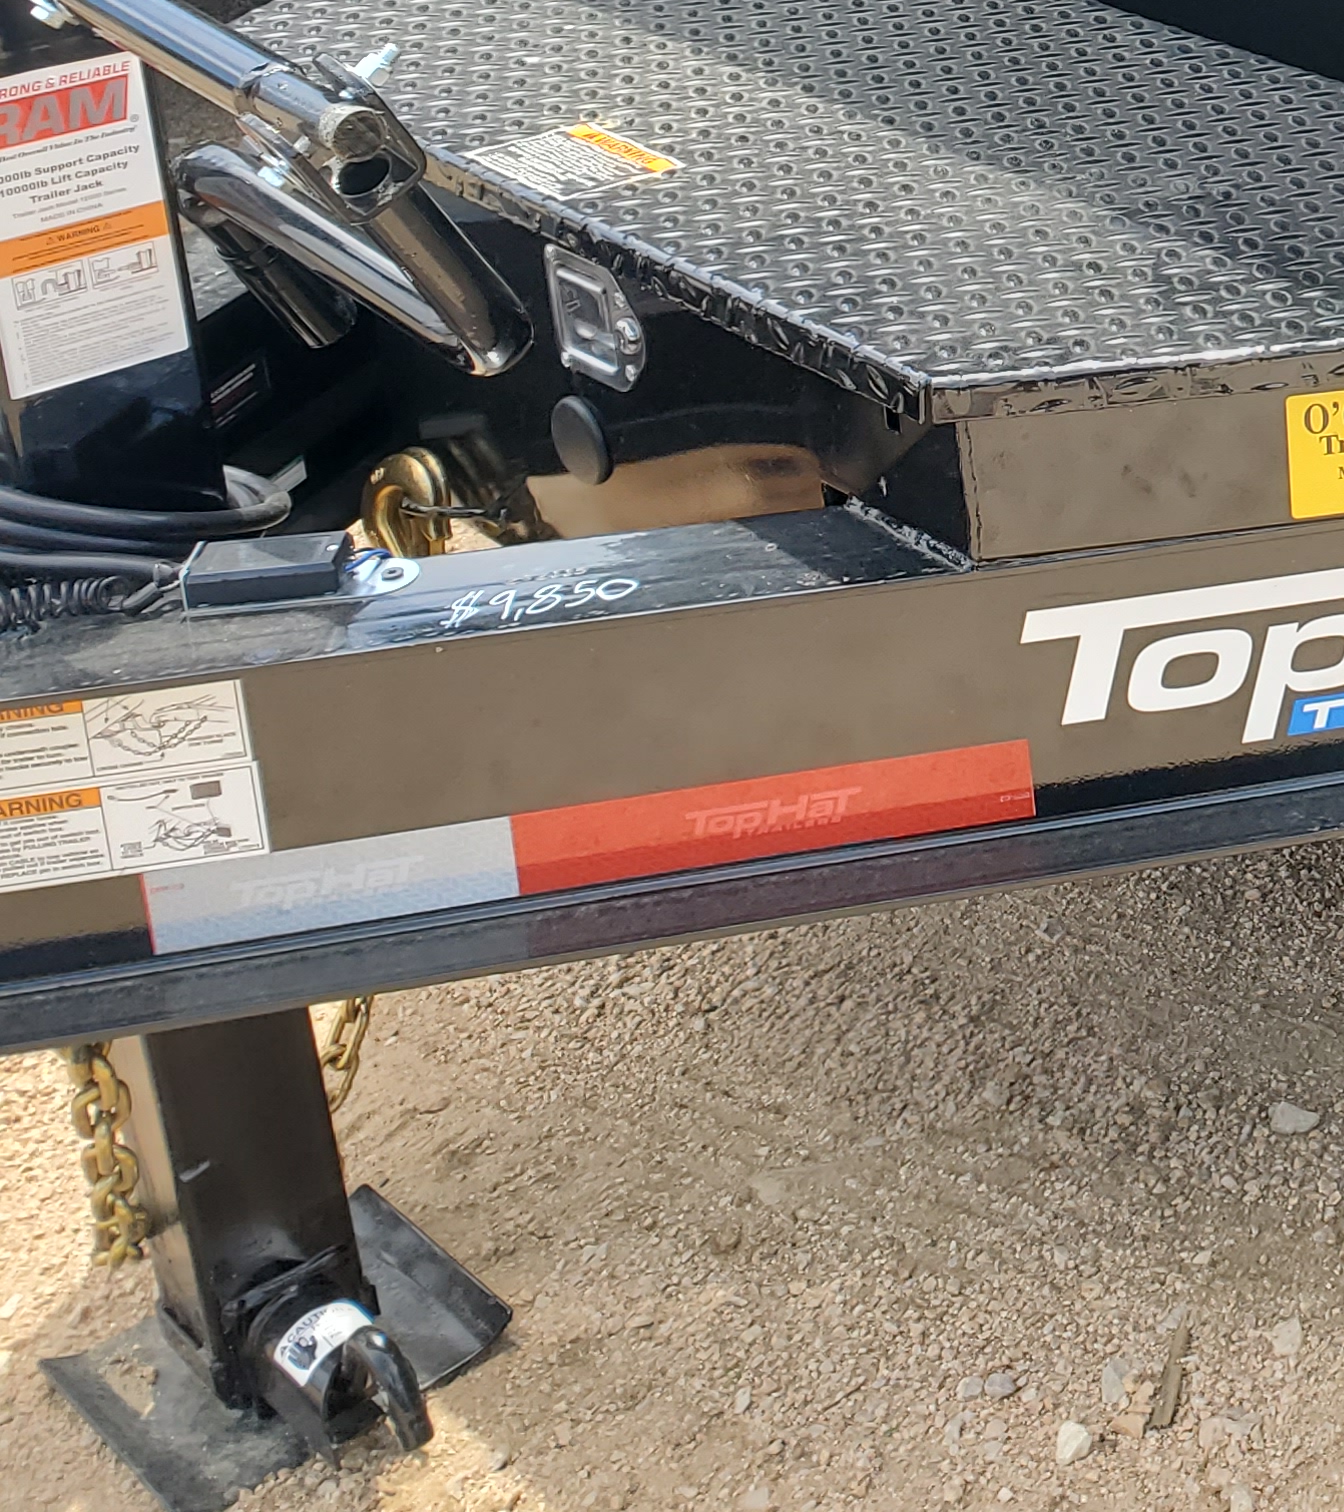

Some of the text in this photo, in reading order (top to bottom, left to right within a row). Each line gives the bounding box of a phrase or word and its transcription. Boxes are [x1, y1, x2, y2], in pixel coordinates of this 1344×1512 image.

[45, 76, 54, 88] &
[59, 61, 130, 85] RELIABLE
[34, 158, 83, 175] Support
[86, 145, 139, 163] Capacity
[600, 133, 658, 164] WARNING
[50, 172, 71, 185] Lift
[74, 161, 127, 178] Capacity
[29, 178, 103, 203] Trailer Jack
[57, 226, 100, 242] WARNING
[440, 578, 640, 629] $9,850
